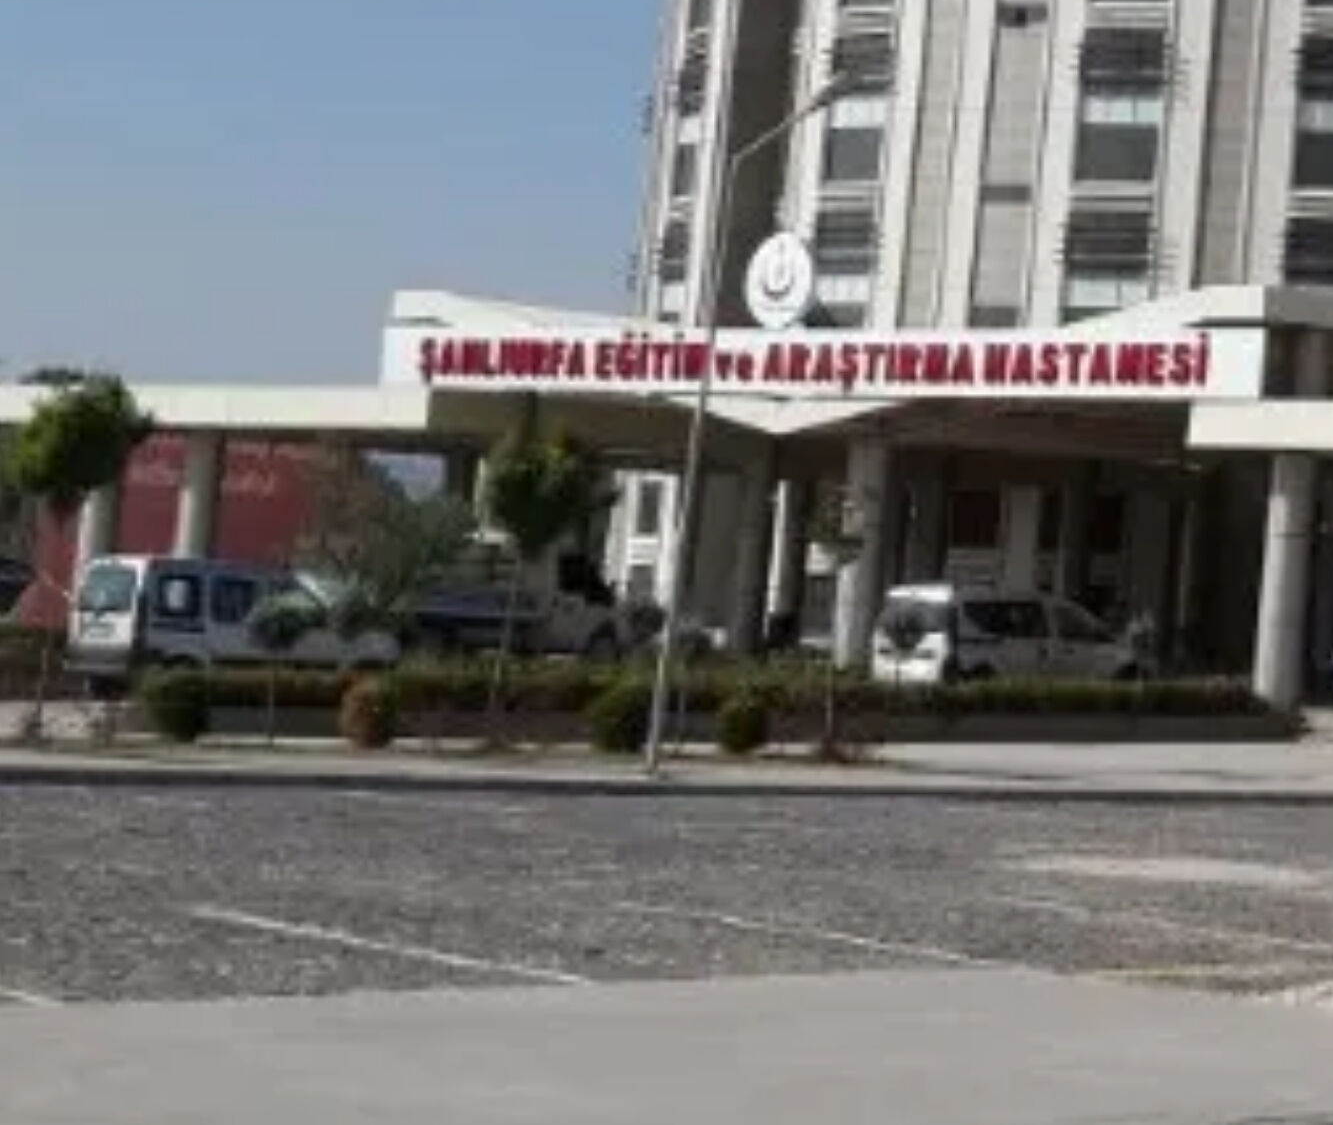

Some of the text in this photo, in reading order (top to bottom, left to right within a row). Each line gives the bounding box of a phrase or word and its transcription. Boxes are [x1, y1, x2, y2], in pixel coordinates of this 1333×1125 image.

[420, 331, 1210, 393] ŞANLIURFA EĞİTİM ve ARAŞTIRMA HASTANESİ
